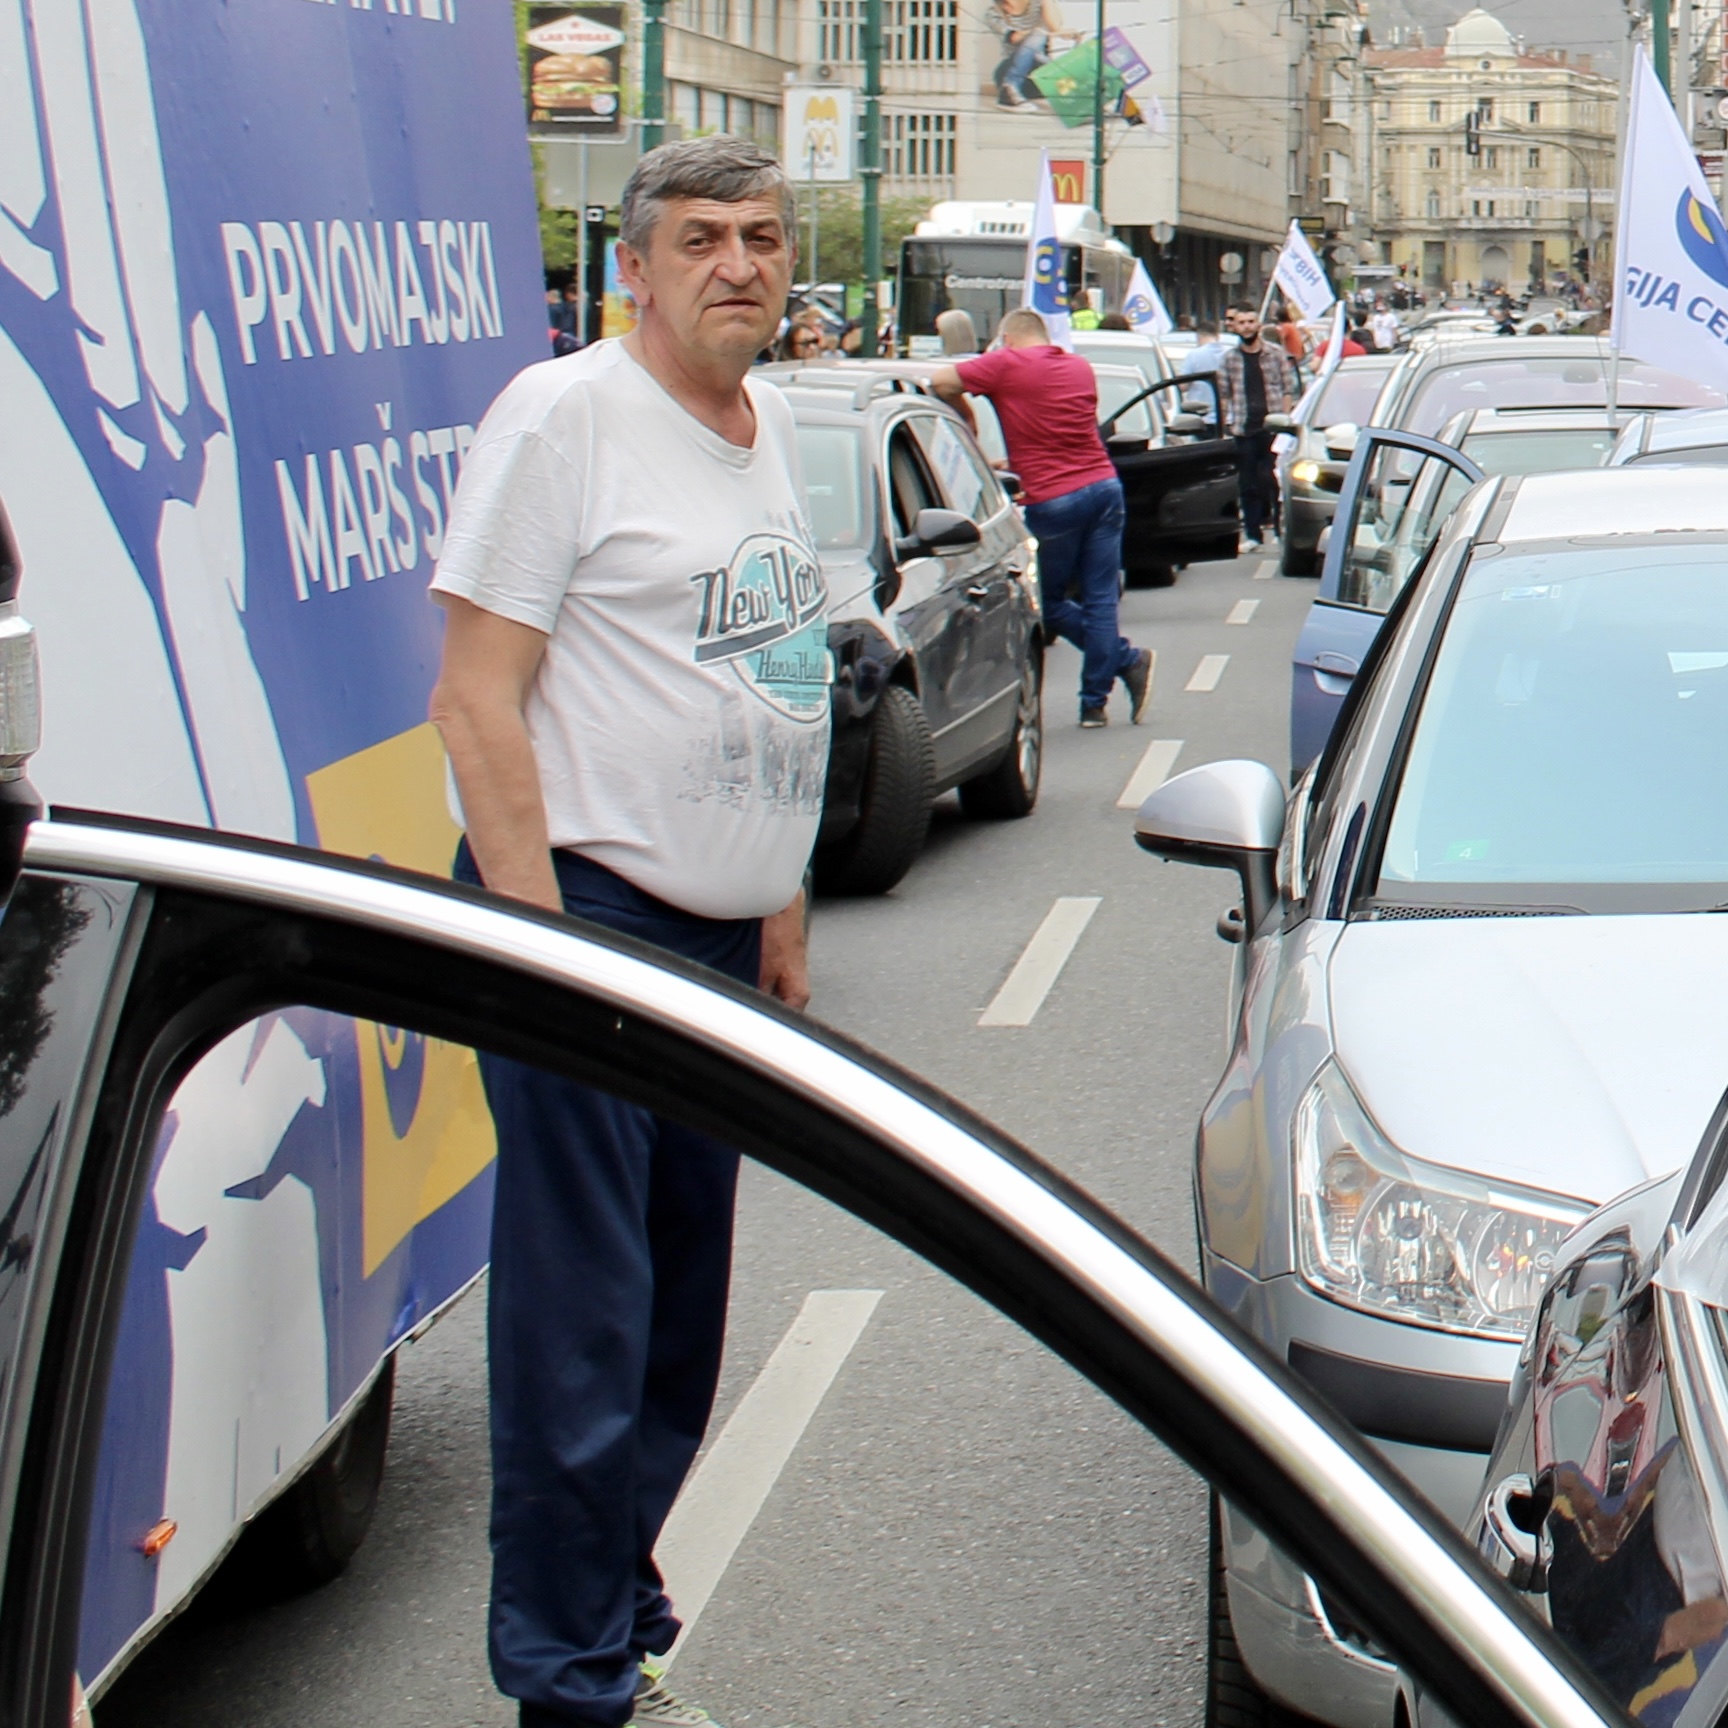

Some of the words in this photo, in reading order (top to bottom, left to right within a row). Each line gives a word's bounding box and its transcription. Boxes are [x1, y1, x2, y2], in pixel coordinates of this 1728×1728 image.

[221, 220, 505, 365] PRVOMAJSKI
[274, 401, 418, 603] MARŠ
[689, 566, 772, 639] New
